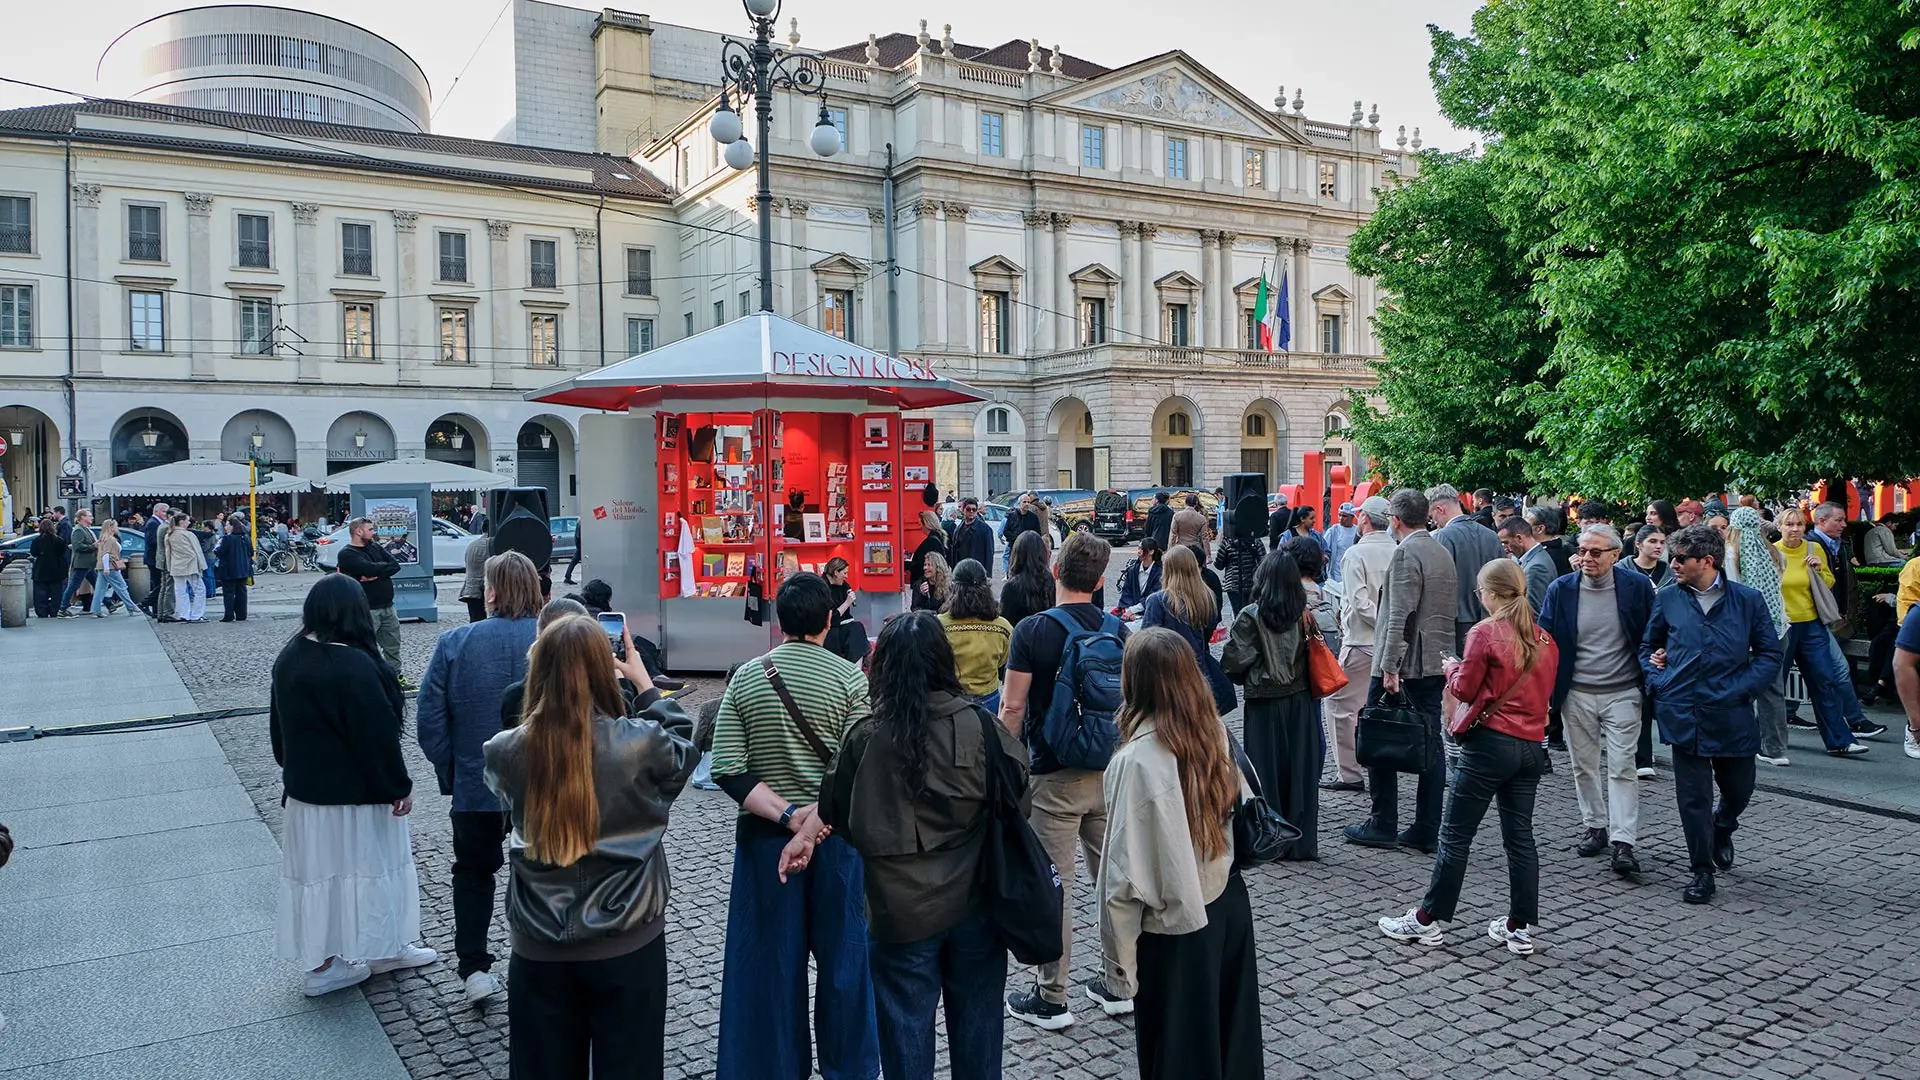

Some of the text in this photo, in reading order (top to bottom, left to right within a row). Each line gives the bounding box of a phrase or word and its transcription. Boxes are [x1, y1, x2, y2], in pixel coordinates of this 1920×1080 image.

[773, 351, 938, 381] DESIGN KIOSK
[328, 449, 389, 458] RISTORANTE
[377, 525, 408, 533] MILANO
